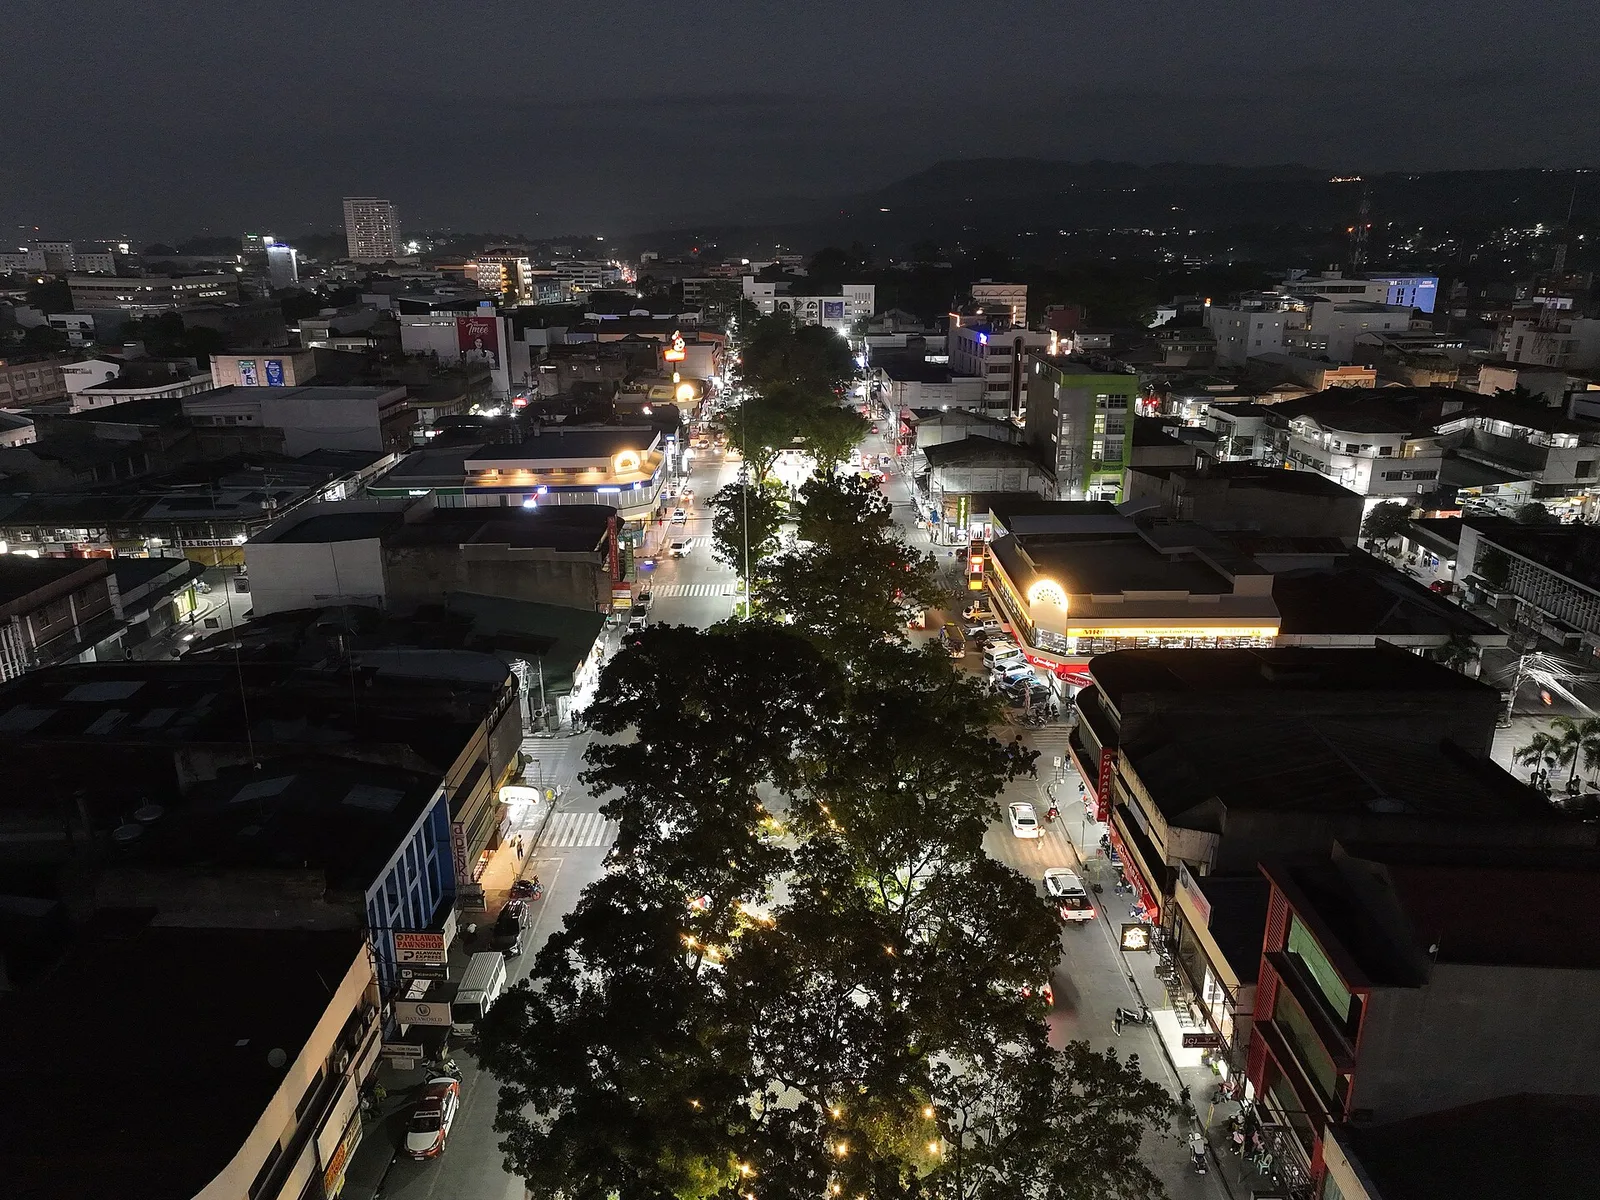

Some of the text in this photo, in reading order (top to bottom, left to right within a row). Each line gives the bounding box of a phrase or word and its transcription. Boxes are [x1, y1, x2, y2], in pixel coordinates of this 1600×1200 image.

[1100, 754, 1111, 813] CHINABANK
[404, 934, 443, 942] PALAWAN
[396, 941, 443, 949] PAWNSHOP
